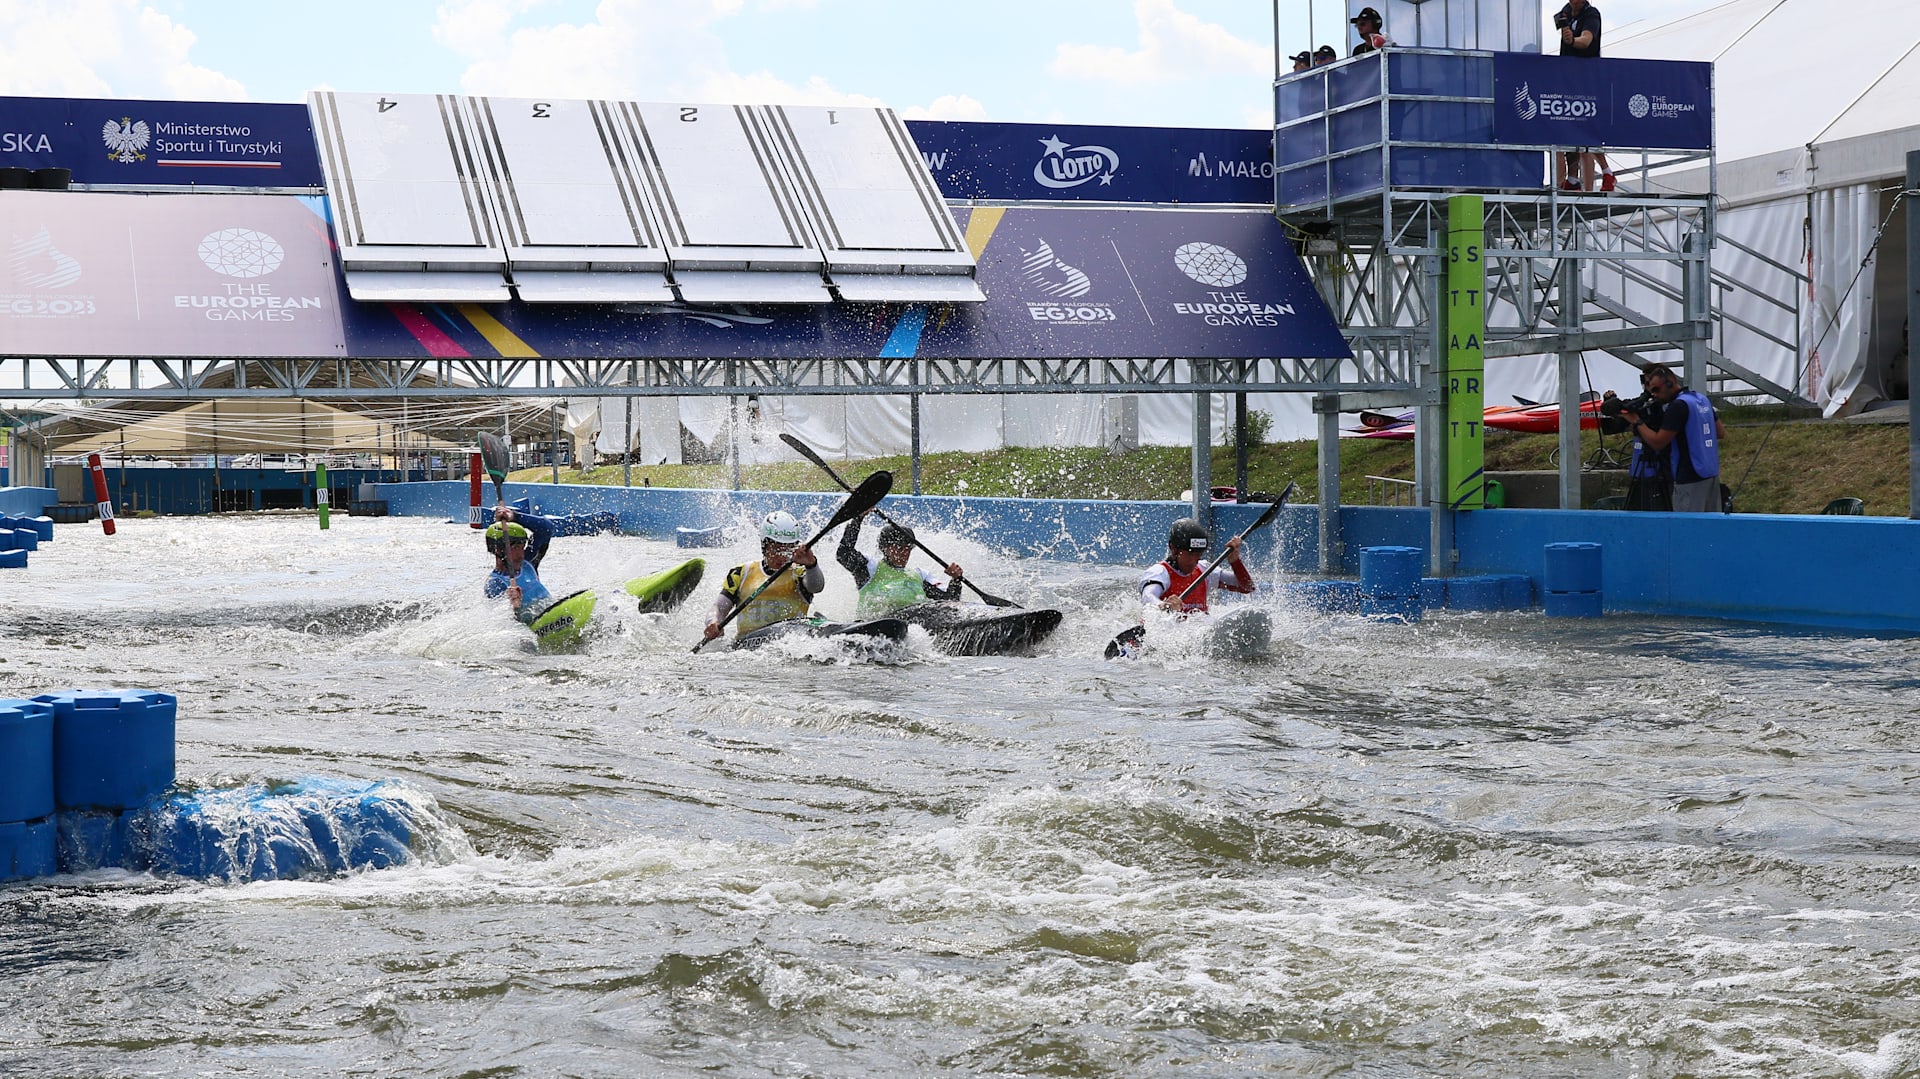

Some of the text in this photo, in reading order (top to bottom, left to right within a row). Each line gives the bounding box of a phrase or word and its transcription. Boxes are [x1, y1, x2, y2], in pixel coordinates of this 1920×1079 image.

[376, 97, 398, 113] 4
[1651, 96, 1667, 104] THE
[532, 102, 551, 118] 3
[680, 107, 698, 122] 2
[1540, 100, 1597, 117] EG2023
[1651, 103, 1695, 112] EUROPEAN
[155, 122, 251, 137] Ministerstwo
[0, 132, 53, 153] SKA
[155, 138, 282, 156] Sportu i Turystyki
[221, 283, 272, 296] THE
[174, 295, 321, 309] EUROPEAN
[1206, 291, 1250, 303] THE
[205, 308, 295, 322] GAMES
[1028, 307, 1117, 321] EG2023
[1173, 302, 1296, 315] EUROPEAN
[1204, 314, 1279, 327] GAMES
